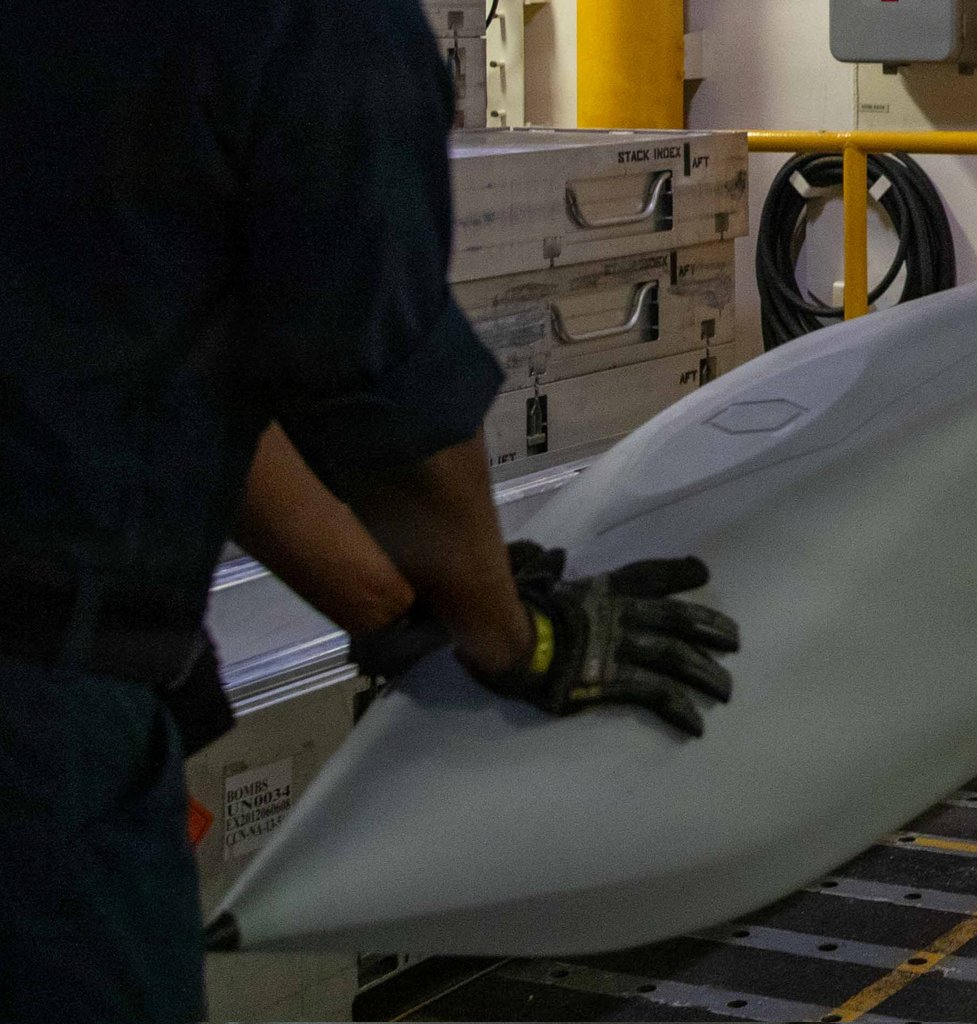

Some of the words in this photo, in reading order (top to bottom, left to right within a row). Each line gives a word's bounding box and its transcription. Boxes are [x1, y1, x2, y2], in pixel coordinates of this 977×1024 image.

[617, 149, 650, 164] STACK
[653, 146, 681, 161] INDEX
[692, 156, 710, 169] AFT
[679, 369, 698, 385] AFT
[226, 779, 269, 804] BOMBS
[226, 785, 291, 817] UN0034
